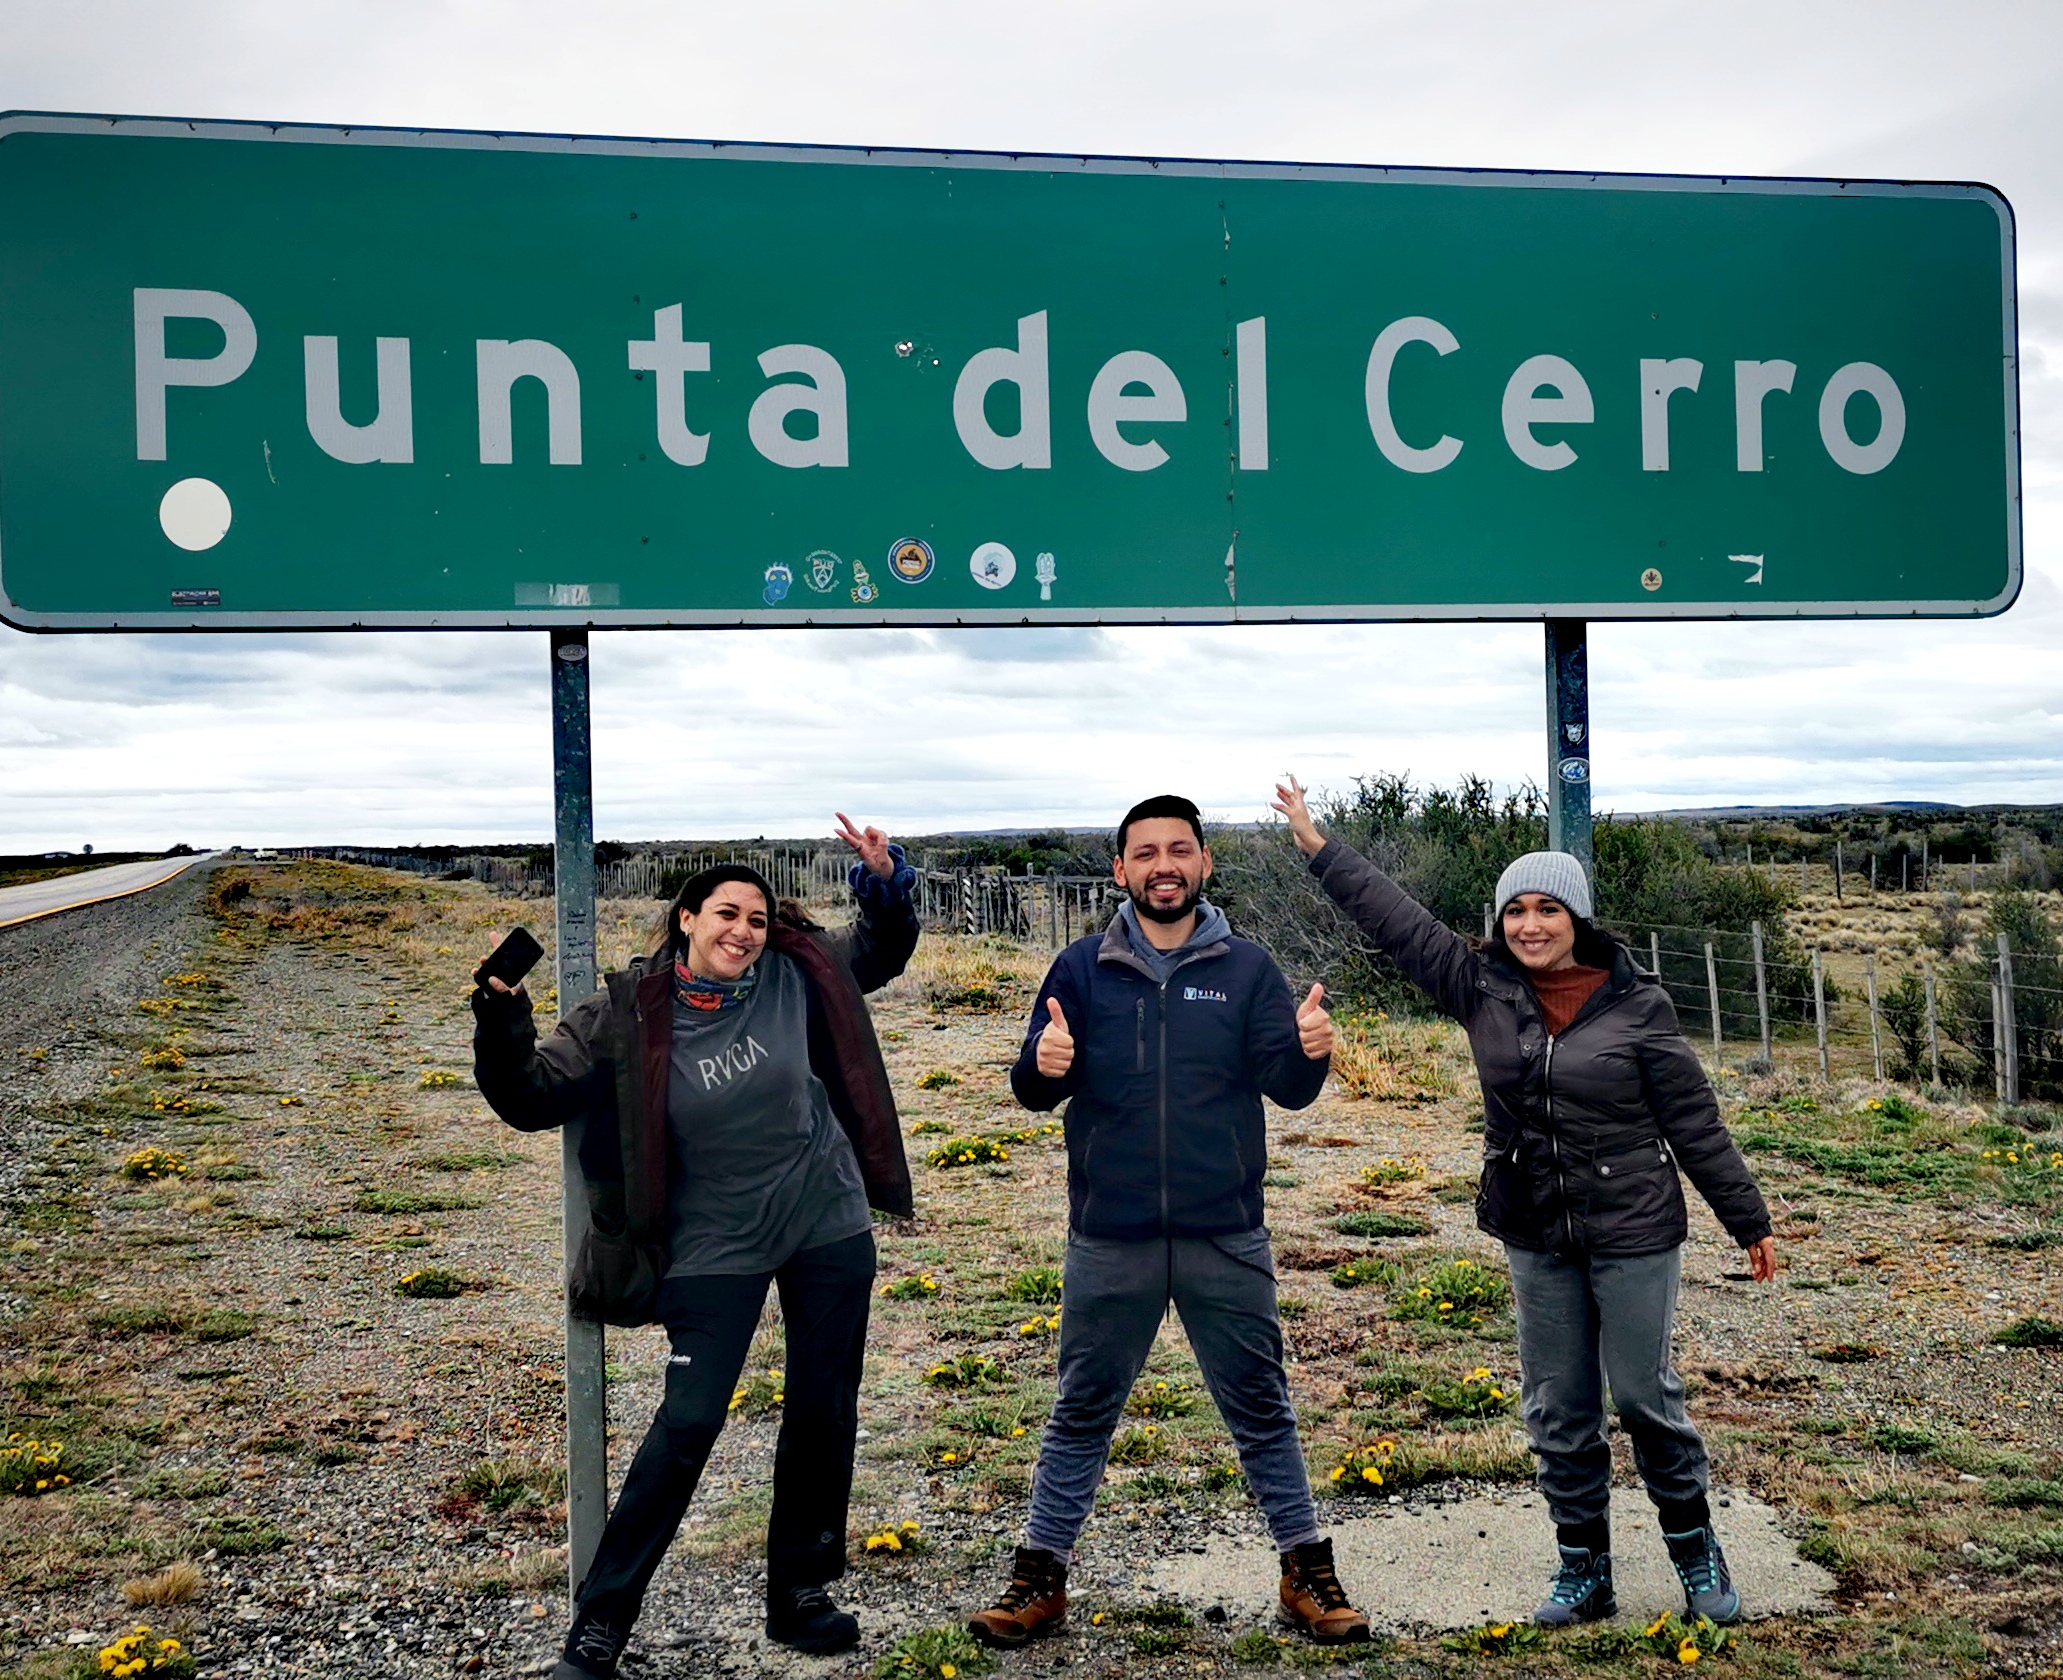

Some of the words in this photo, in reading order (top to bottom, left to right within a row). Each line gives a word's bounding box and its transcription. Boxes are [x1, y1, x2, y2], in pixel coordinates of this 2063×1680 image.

[134, 289, 849, 470] Punta
[954, 310, 1269, 471] del
[1366, 317, 1906, 475] Cerro
[1198, 989, 1227, 998] VITAL
